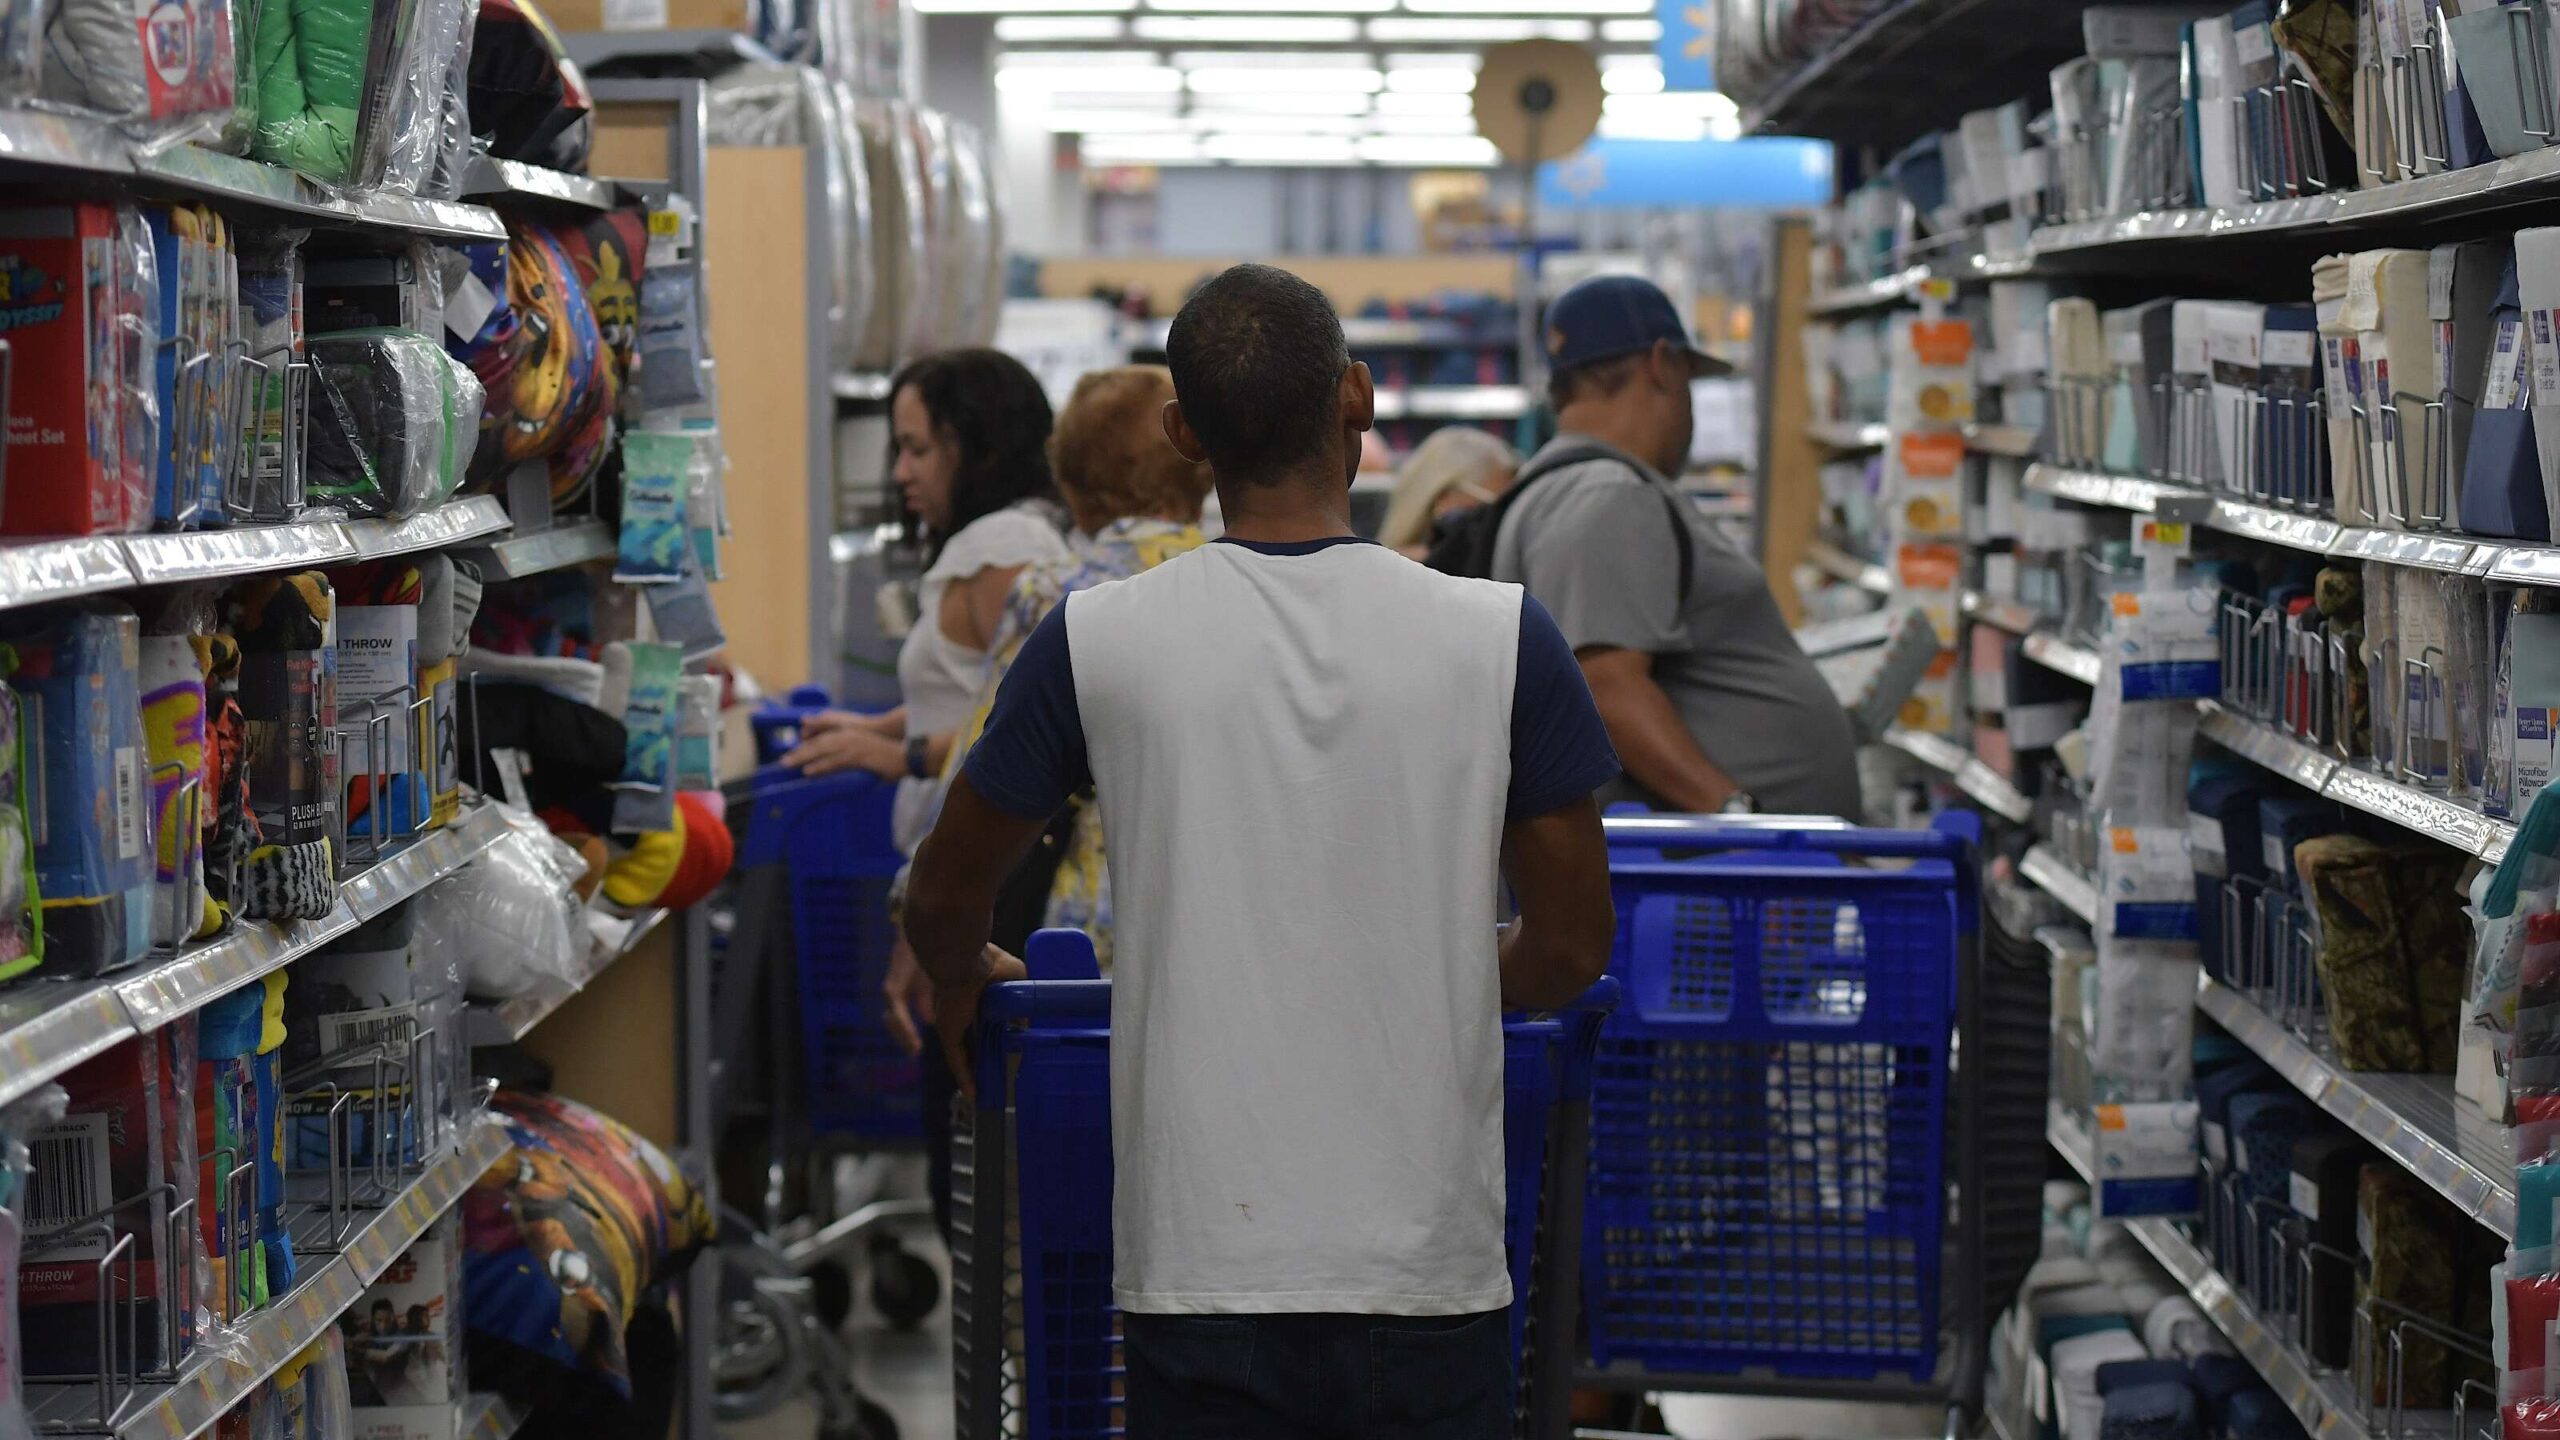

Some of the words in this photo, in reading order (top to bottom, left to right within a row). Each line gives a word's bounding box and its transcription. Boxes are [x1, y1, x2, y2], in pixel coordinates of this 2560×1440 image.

[41, 428, 65, 445] Set
[343, 638, 393, 650] THROW
[2518, 777, 2548, 788] Pillowcas
[2519, 787, 2531, 798] Set
[291, 803, 315, 821] PLUSH
[28, 1269, 75, 1283] THROW
